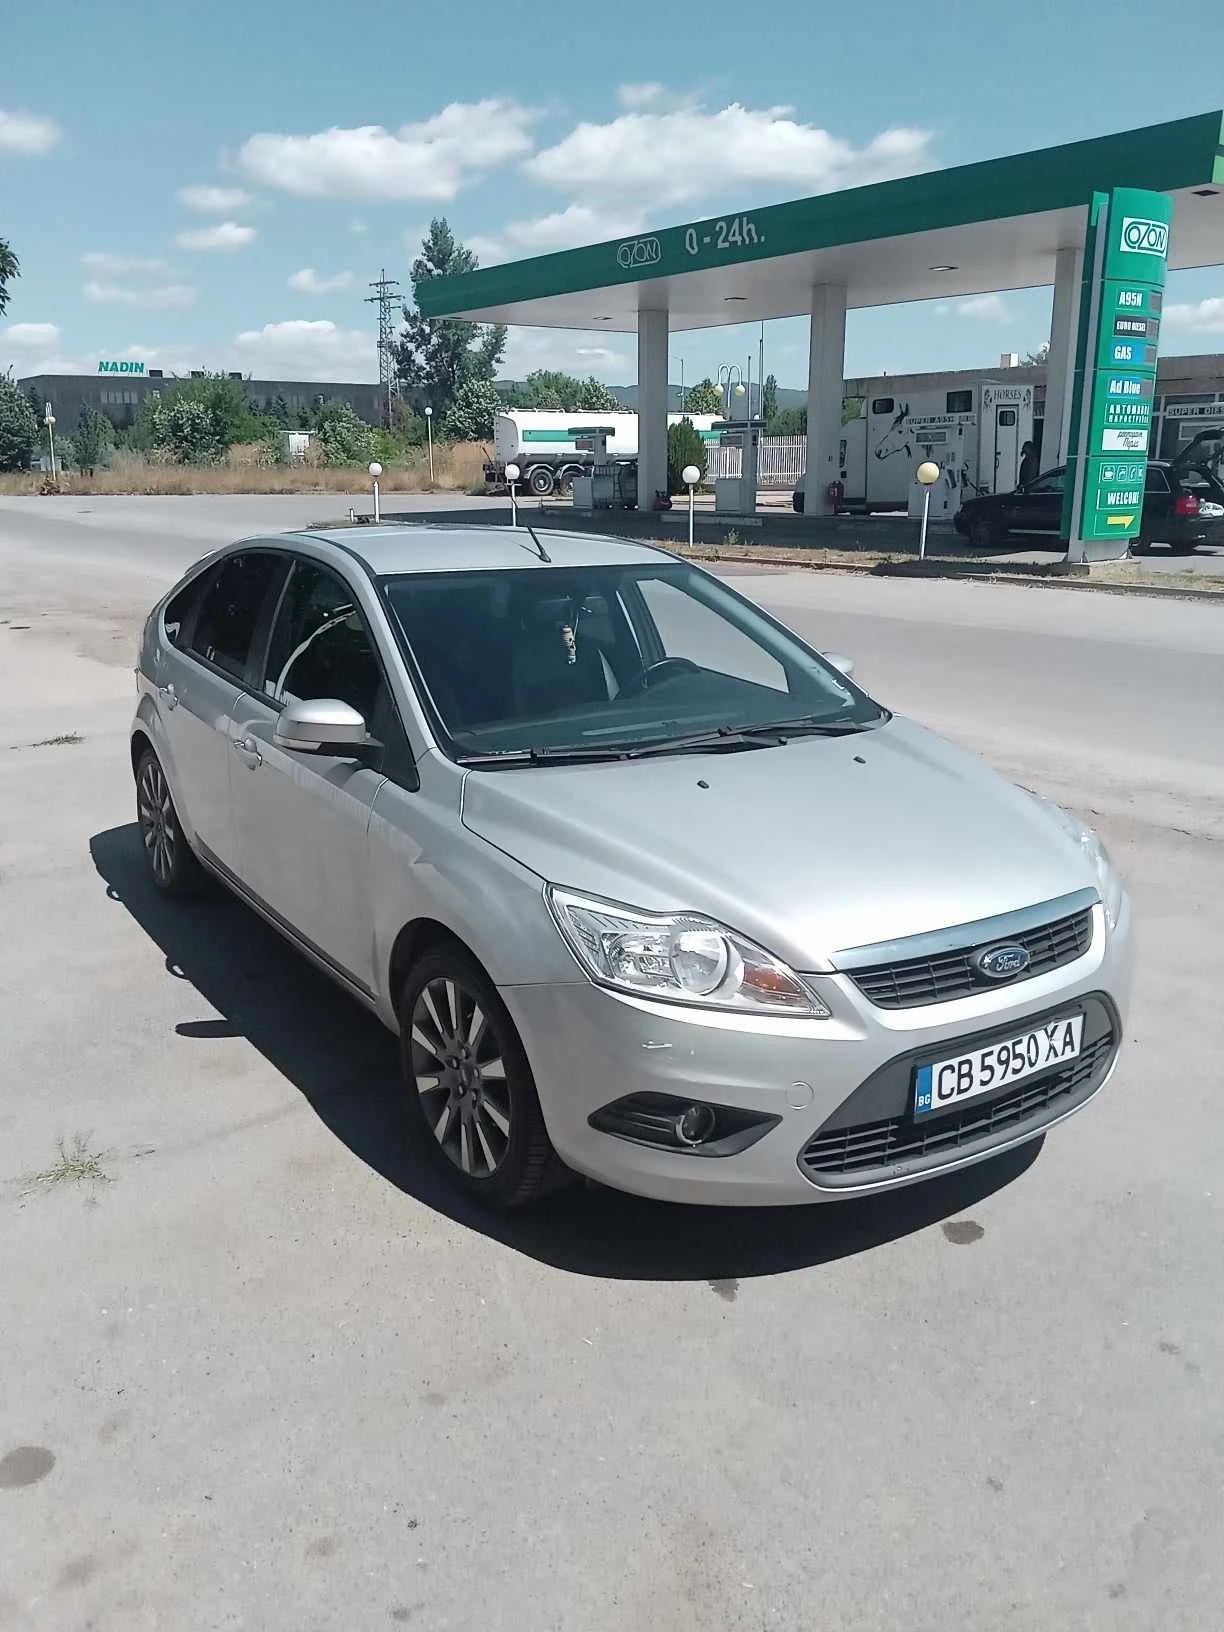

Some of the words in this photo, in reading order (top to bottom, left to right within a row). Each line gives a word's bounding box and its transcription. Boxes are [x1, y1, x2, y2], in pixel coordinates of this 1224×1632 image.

[1124, 221, 1167, 254] OZON
[617, 237, 661, 268] OZON
[1114, 345, 1132, 360] GAS
[98, 361, 144, 373] NADIN
[1110, 380, 1121, 394] Ad
[995, 954, 1021, 973] Ford
[918, 1095, 931, 1107] BG
[979, 1033, 1040, 1087] 5950
